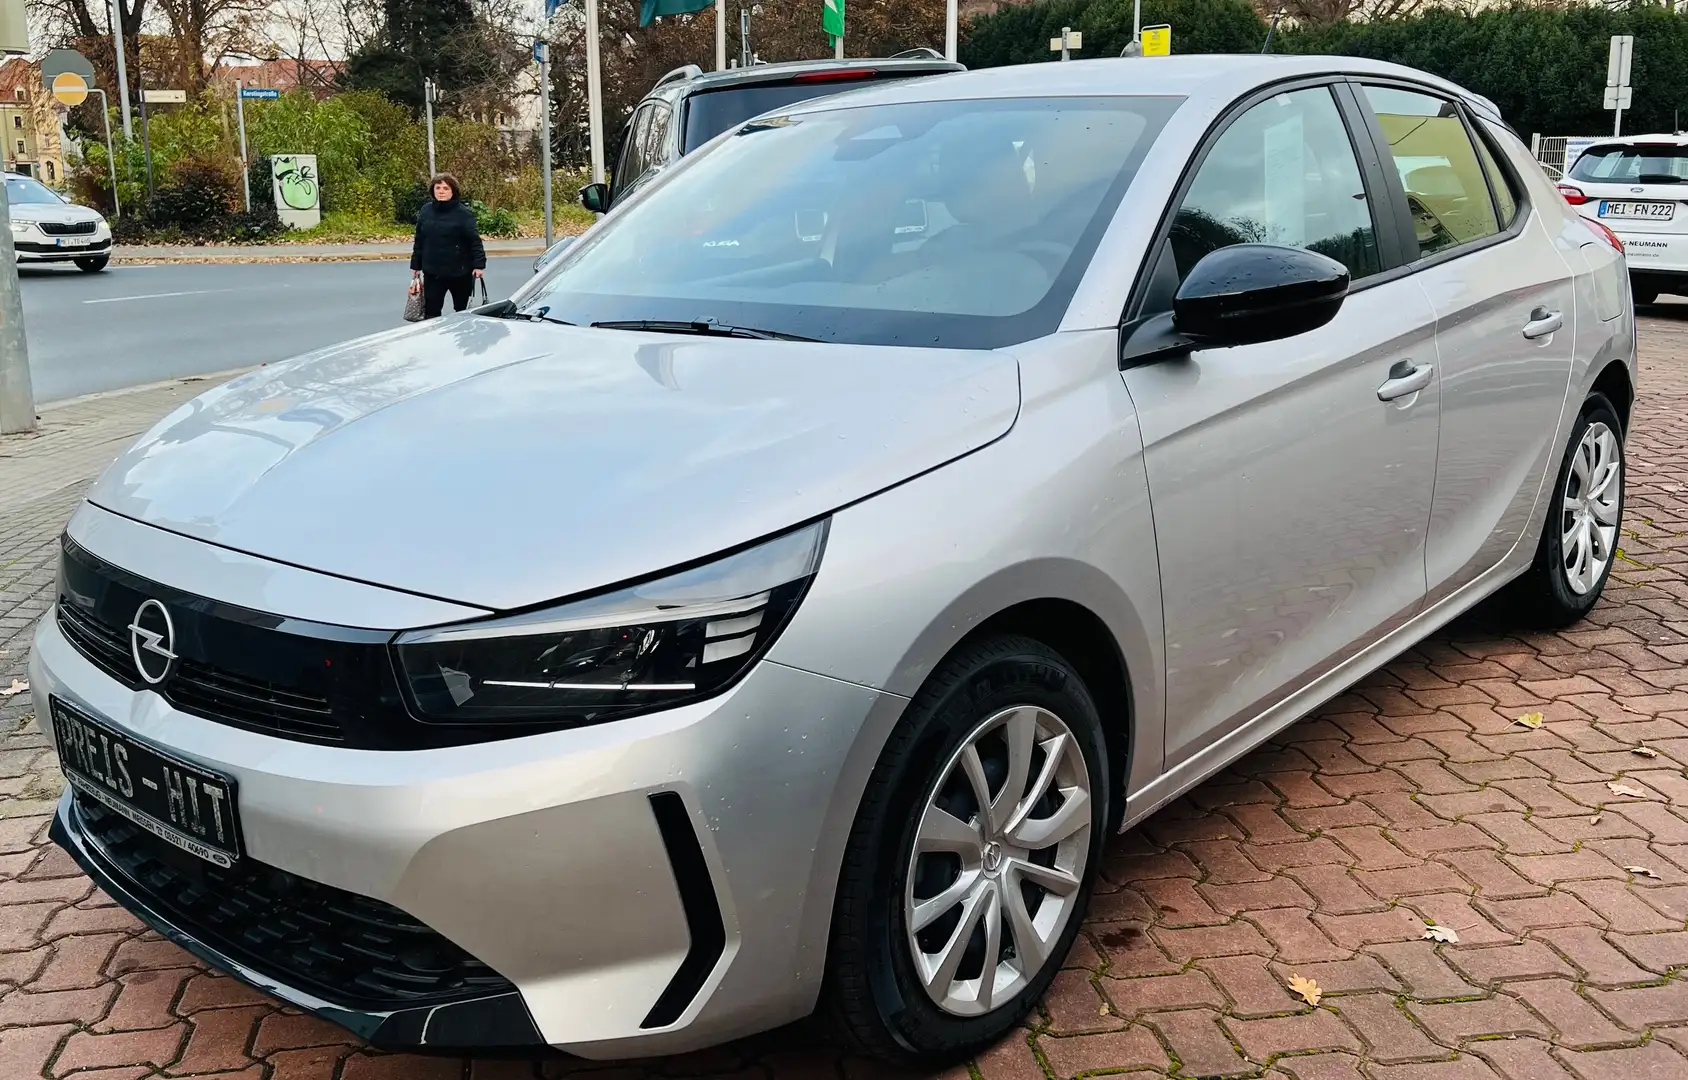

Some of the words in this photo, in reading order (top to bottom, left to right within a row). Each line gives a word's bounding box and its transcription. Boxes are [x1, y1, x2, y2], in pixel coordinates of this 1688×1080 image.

[1607, 203, 1627, 215] MEI
[1634, 204, 1649, 215] FN
[1650, 205, 1672, 216] 222
[56, 710, 134, 798] PREIS
[162, 766, 225, 843] HIT
[188, 842, 209, 859] 40690
